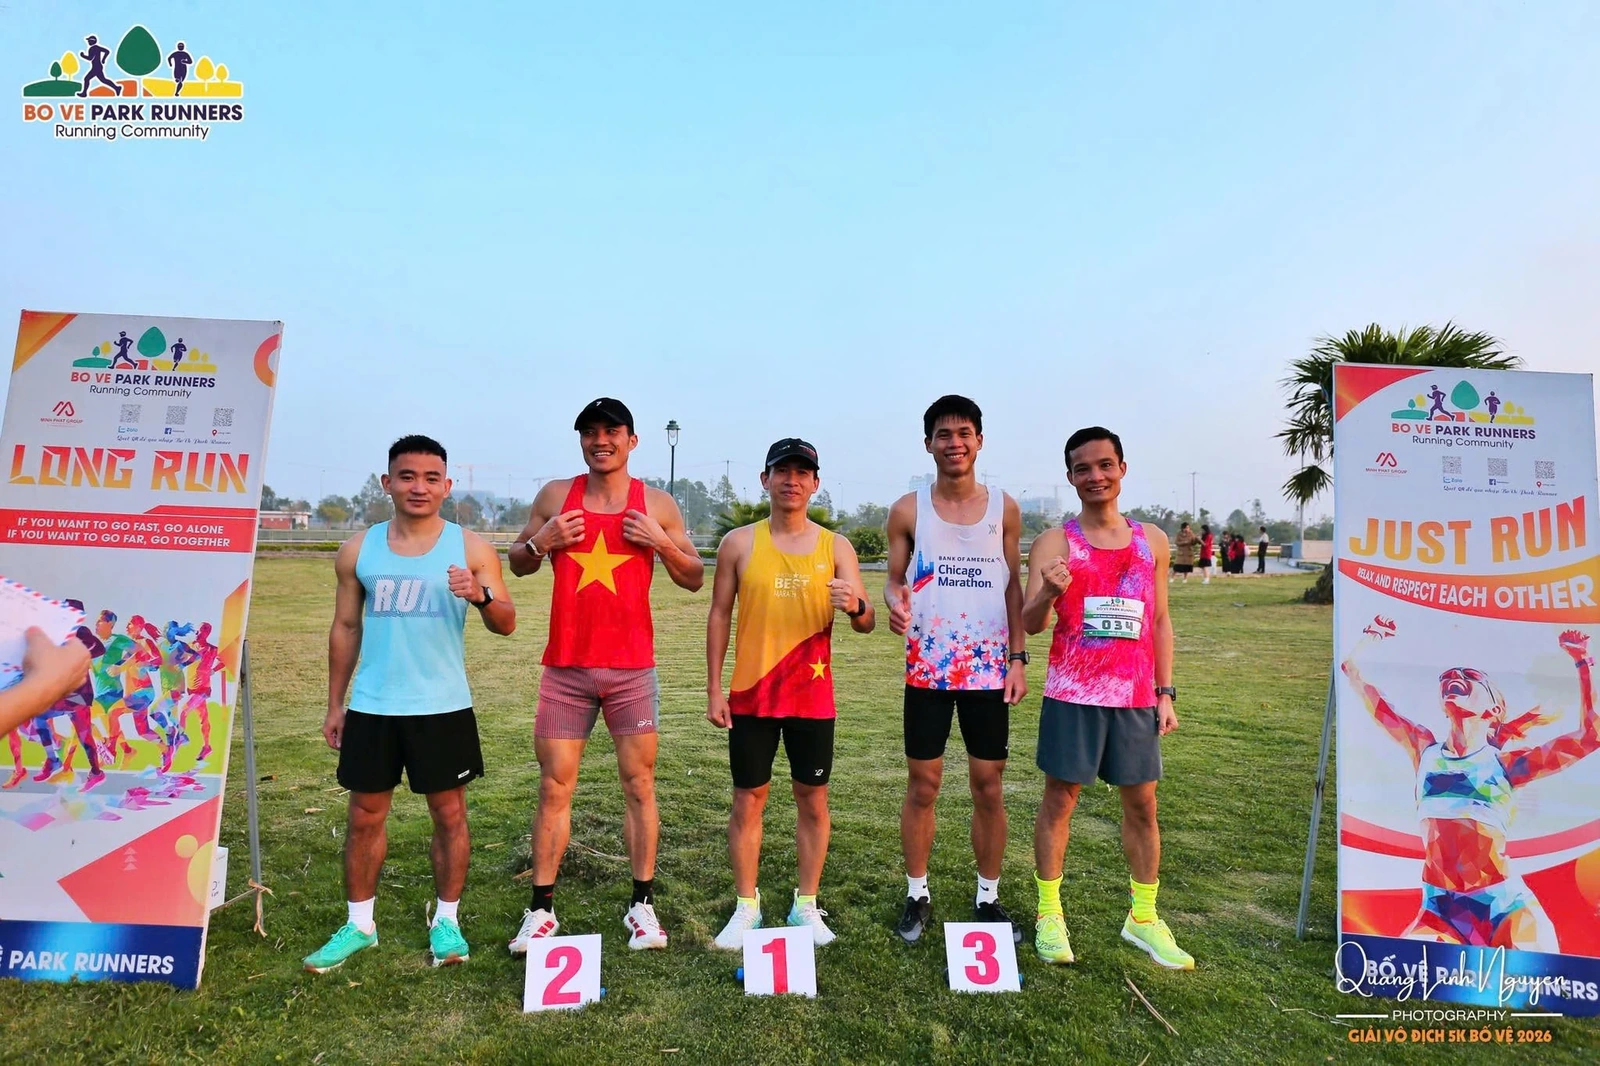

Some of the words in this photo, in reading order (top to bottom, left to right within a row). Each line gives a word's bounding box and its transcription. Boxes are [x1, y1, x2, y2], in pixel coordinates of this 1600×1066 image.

[71, 372, 90, 383] BO
[95, 373, 111, 383] VE
[115, 374, 151, 385] PARK
[154, 376, 215, 388] RUNNERS
[90, 385, 130, 397] Running
[133, 387, 192, 399] Community
[1392, 423, 1411, 433] BO
[1415, 424, 1431, 434] VE
[1435, 425, 1470, 436] PARK
[1475, 427, 1536, 439] RUNNERS
[1412, 436, 1453, 447] Running
[1455, 438, 1514, 449] Community
[8, 444, 136, 488] LONG
[150, 450, 249, 493] RUN
[18, 518, 27, 526] IF
[31, 518, 54, 527] YOU
[57, 519, 90, 529] WANT
[93, 521, 108, 529] TO
[111, 521, 130, 530] GO
[133, 522, 160, 533] FAST,
[164, 523, 182, 532] GO
[186, 525, 224, 534] ALONE
[1349, 518, 1471, 565] JUST
[1490, 495, 1586, 563] RUN
[7, 529, 17, 538] IF
[21, 530, 44, 539] YOU
[47, 531, 80, 541] WANT
[83, 532, 98, 541] TO
[101, 533, 120, 543] GO
[123, 534, 147, 545] FAR,
[151, 535, 169, 544] GO
[173, 536, 230, 547] TOGETHER
[938, 564, 982, 578] Chicago
[774, 577, 810, 590] BEST
[1357, 567, 1374, 582] RELAX
[1375, 574, 1390, 588] AND
[1392, 576, 1437, 602] RESPECT
[1439, 584, 1487, 608] EACH
[1494, 574, 1597, 609] OTHER
[1102, 620, 1133, 631] 034
[9, 950, 67, 970] PARK
[74, 952, 175, 974] RUNNERS
[762, 937, 788, 994] 1
[962, 931, 1000, 985] 3
[542, 946, 582, 1005] 2
[1502, 974, 1599, 1001] UNNERS
